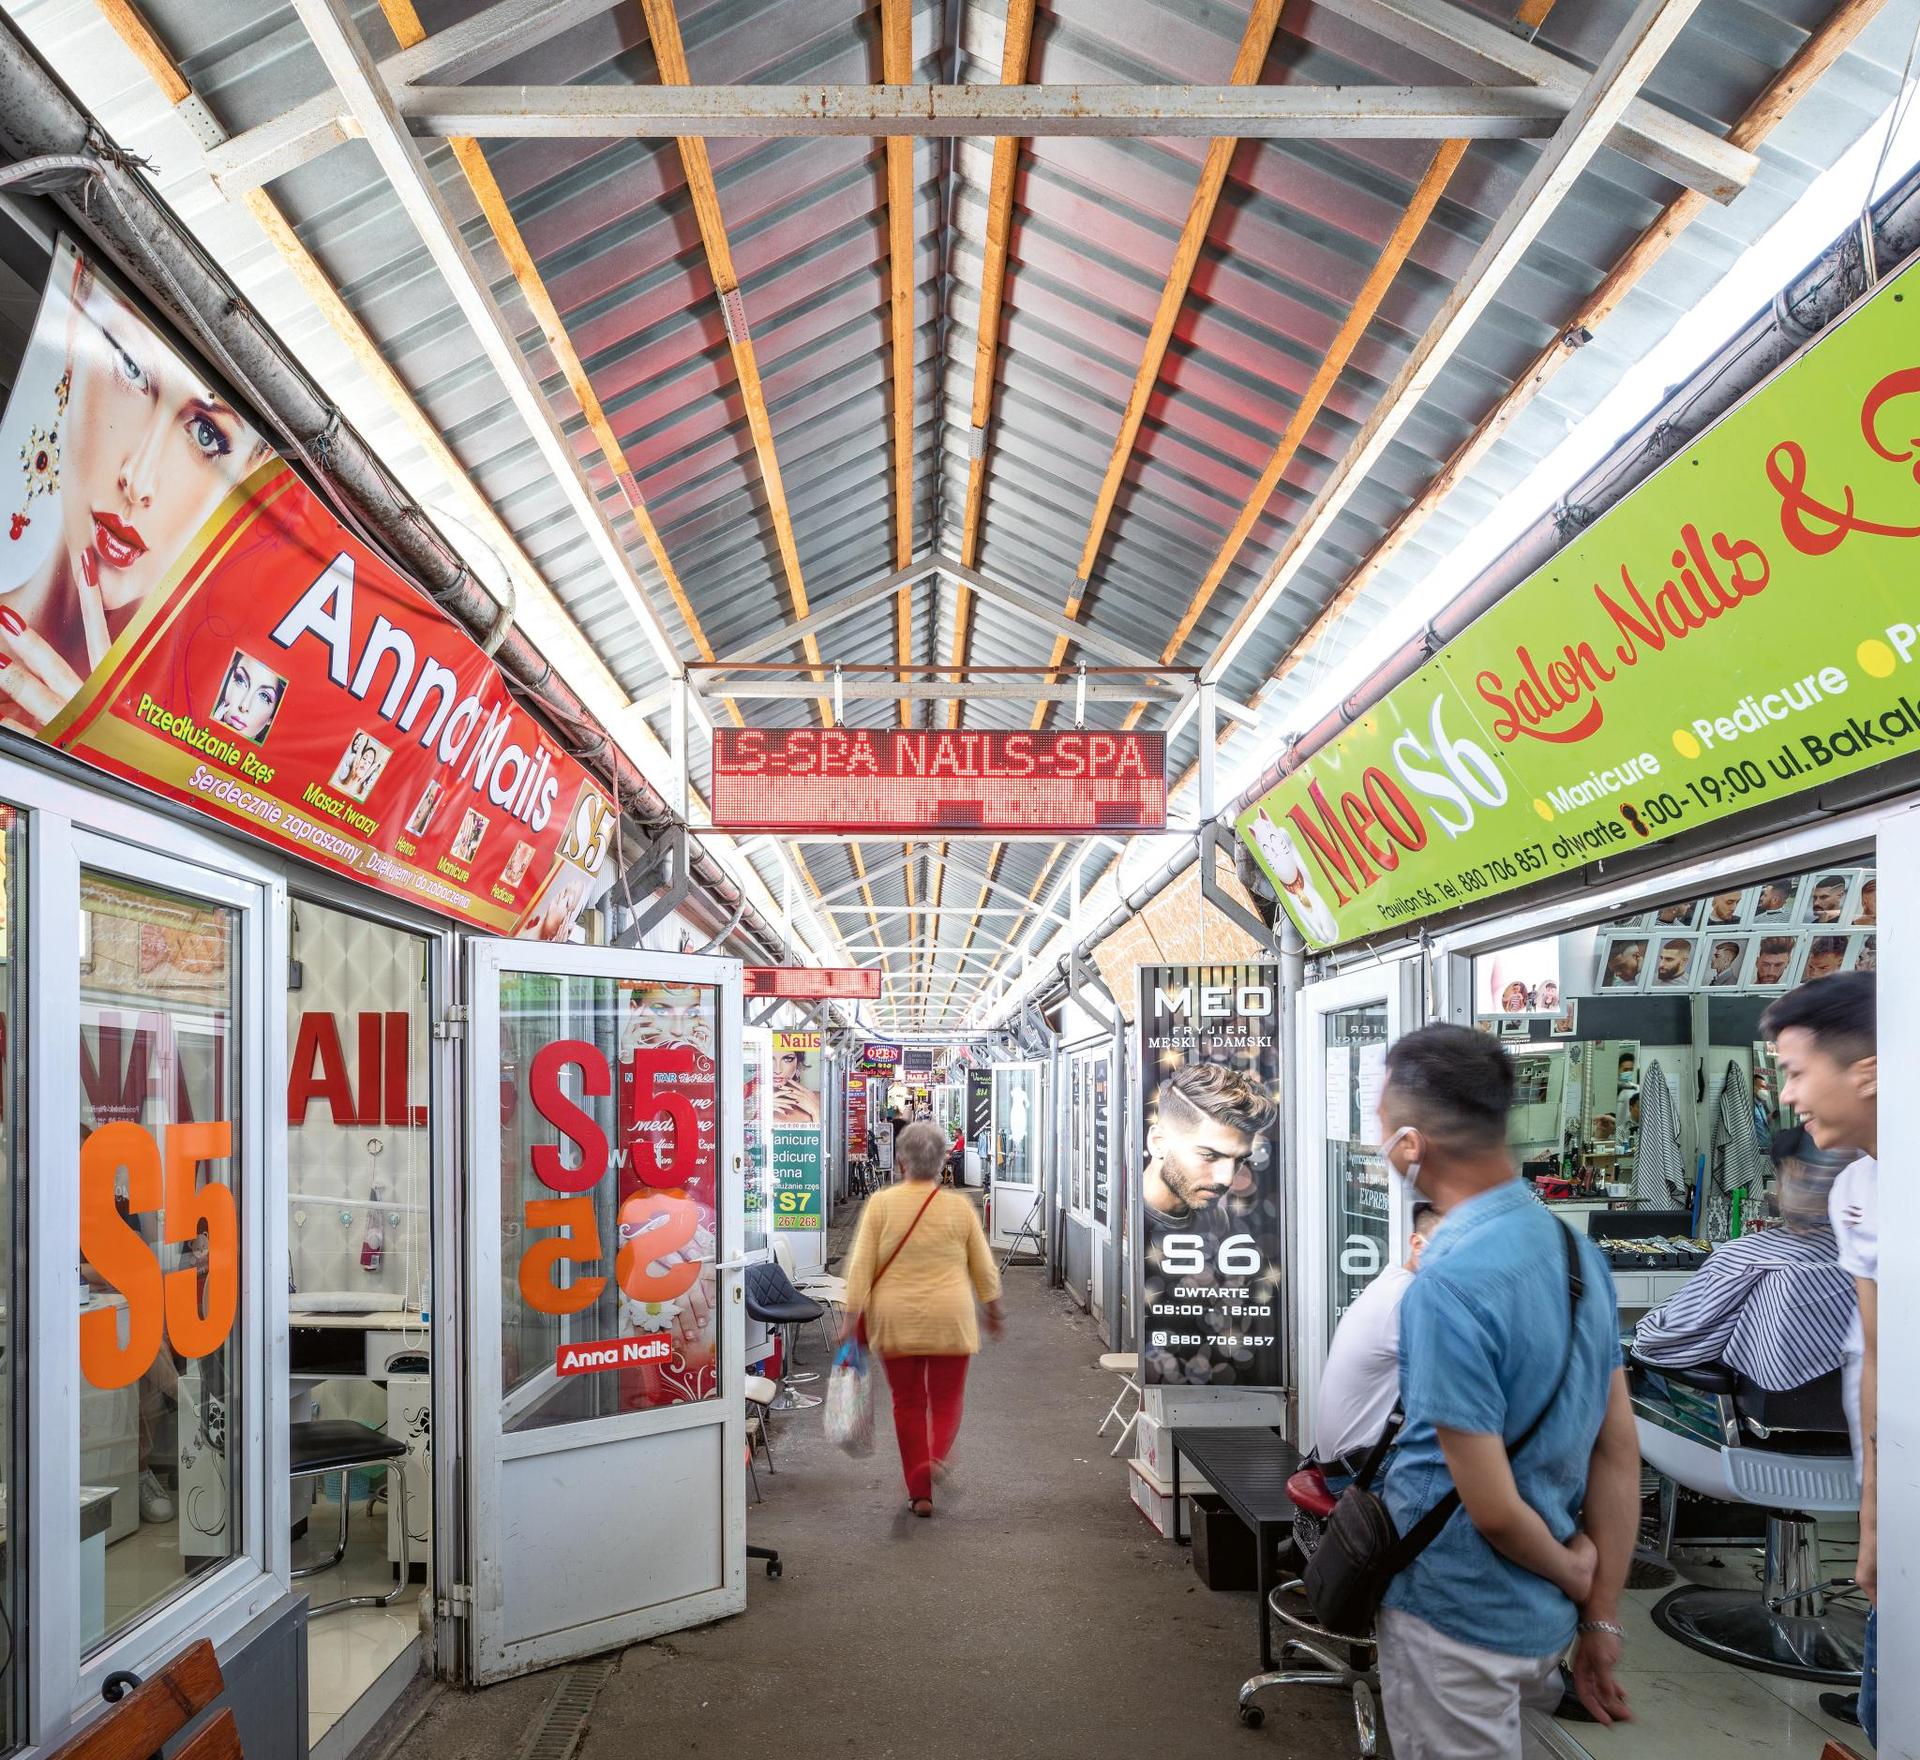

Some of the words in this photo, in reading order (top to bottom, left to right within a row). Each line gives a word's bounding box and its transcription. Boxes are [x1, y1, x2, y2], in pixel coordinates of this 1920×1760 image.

[1476, 641, 1616, 746] Salon
[1593, 523, 1770, 667] Nails
[268, 551, 485, 768] Anna
[461, 701, 560, 834] Nails
[1692, 666, 1849, 750] Pedicure
[136, 692, 240, 767] Przedłużanie
[242, 751, 276, 785] Rzęs
[896, 735, 1147, 776] NAILS-SPA
[1394, 692, 1509, 841] S6
[1551, 750, 1660, 816] Manicure
[302, 782, 347, 819] Masaż
[343, 803, 380, 839] twarzy
[188, 764, 283, 824] Serdecznie
[281, 813, 363, 865] zapraszamy
[366, 851, 412, 886] Dziękujemy
[415, 873, 428, 889] do
[426, 880, 471, 909] zobaczenia
[394, 835, 417, 858] Henna
[561, 793, 617, 874] S5
[436, 855, 470, 884] Manicure
[1377, 889, 1421, 920] Pawilon
[1435, 878, 1464, 900] Tel.
[1457, 868, 1488, 892] 880
[1483, 858, 1518, 887] 706
[1514, 844, 1549, 874] 857
[1551, 819, 1628, 860] otwarte
[1154, 986, 1272, 1017] MEO
[780, 1034, 822, 1048] Nails
[1148, 1037, 1196, 1048] MESKI
[1212, 1036, 1272, 1048] DAMSKI
[1172, 1025, 1248, 1035] FRYJIER
[288, 1012, 428, 1125] AIL
[867, 1049, 899, 1059] OPEN
[529, 1039, 707, 1193] S5
[774, 1133, 819, 1145] anicure
[772, 1150, 817, 1163] edicure
[773, 1168, 803, 1178] enna
[779, 1192, 811, 1212] S7
[778, 1216, 796, 1227] 267
[799, 1216, 817, 1227] 268
[80, 1121, 238, 1390] S5
[1160, 1234, 1261, 1276] S6
[1174, 1287, 1250, 1299] OWTARTE
[1152, 1305, 1203, 1315] 08:00
[1221, 1306, 1271, 1317] 18:00
[562, 1348, 619, 1370] Anna
[623, 1341, 670, 1362] Nails
[1170, 1335, 1201, 1345] 880
[1206, 1336, 1238, 1346] 706
[1243, 1336, 1275, 1347] 857
